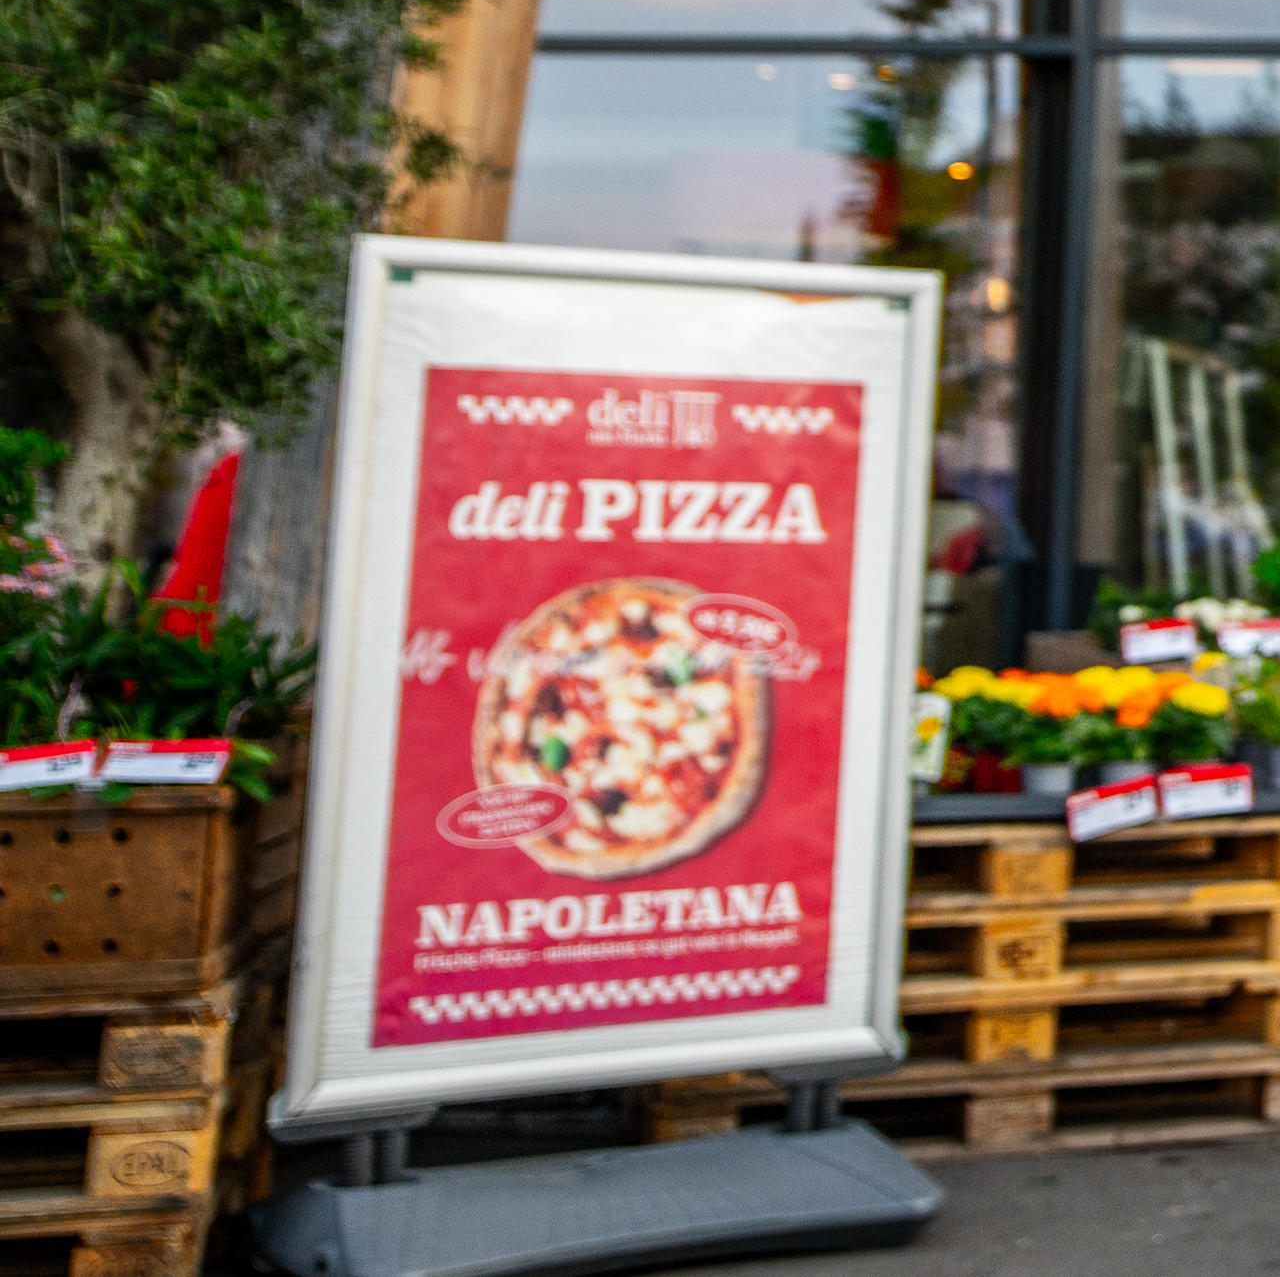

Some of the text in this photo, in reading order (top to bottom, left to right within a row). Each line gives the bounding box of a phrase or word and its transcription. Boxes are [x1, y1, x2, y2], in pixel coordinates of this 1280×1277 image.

[586, 386, 669, 430] deli
[448, 477, 829, 546] deli PIZZA
[415, 879, 803, 949] NAPOLETANA
